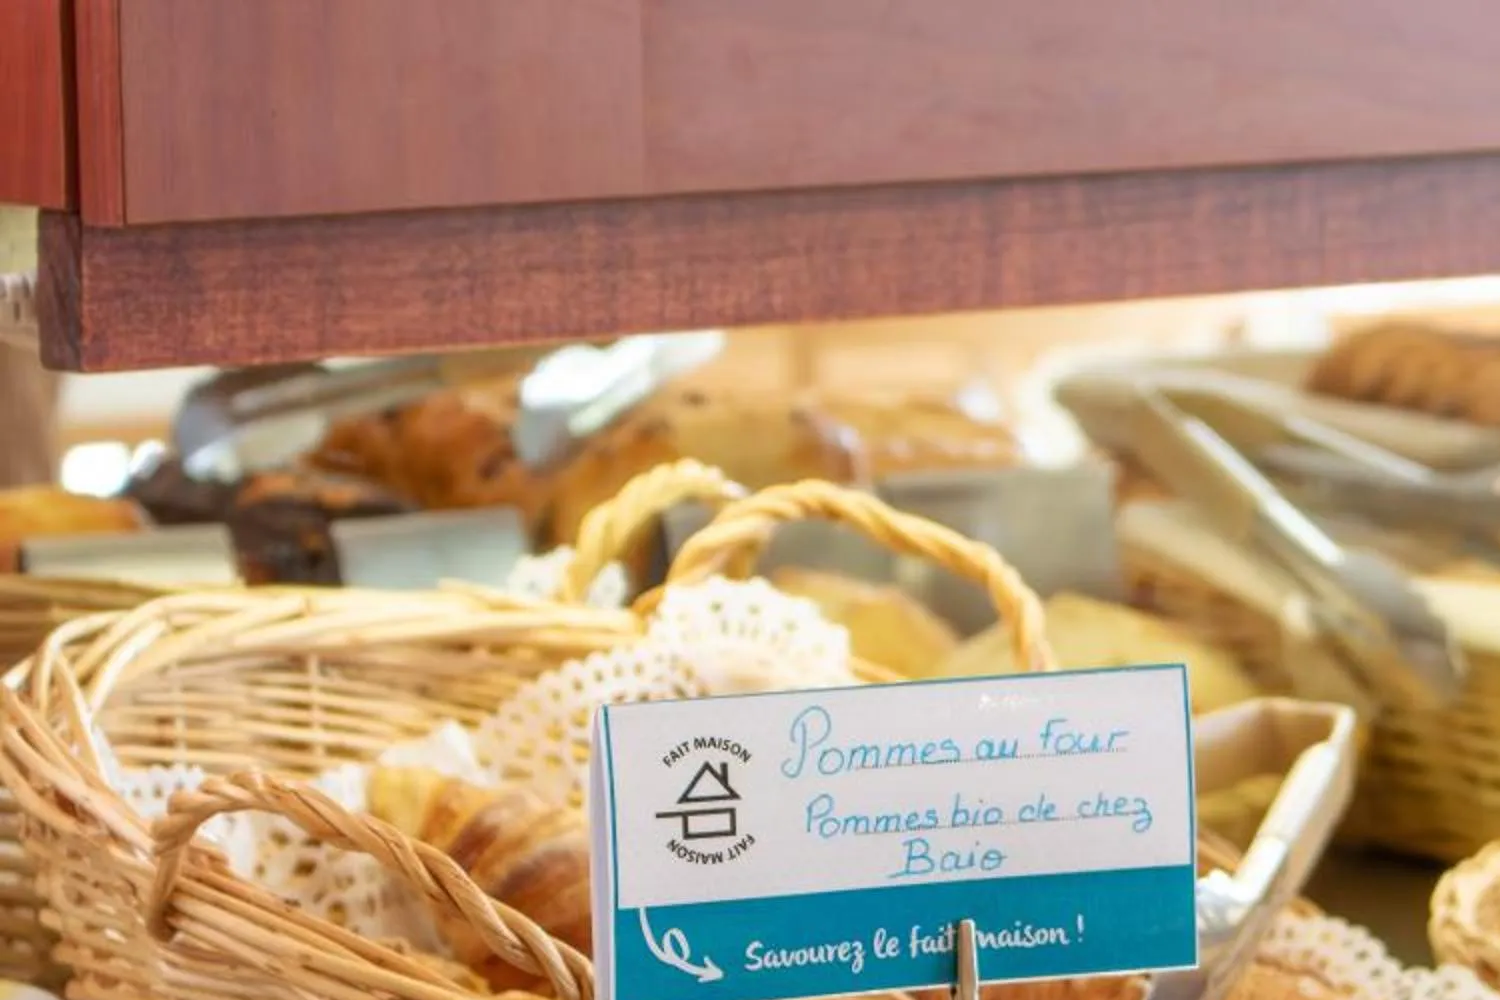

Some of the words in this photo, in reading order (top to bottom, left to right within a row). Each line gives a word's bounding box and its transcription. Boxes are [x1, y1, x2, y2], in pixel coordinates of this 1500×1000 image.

[662, 741, 691, 768] FAIT
[693, 736, 752, 763] MAISON
[781, 705, 962, 779] Pommes
[974, 738, 1020, 761] au
[805, 793, 940, 839] Pommes
[951, 793, 1004, 828] bio
[1018, 793, 1057, 823] de
[1076, 792, 1153, 833] chez
[666, 838, 723, 865] MAISON
[727, 833, 757, 861] FAIT
[744, 939, 867, 975] Savourez
[873, 927, 901, 959] le
[909, 923, 957, 958] fait
[1076, 913, 1086, 943] !
